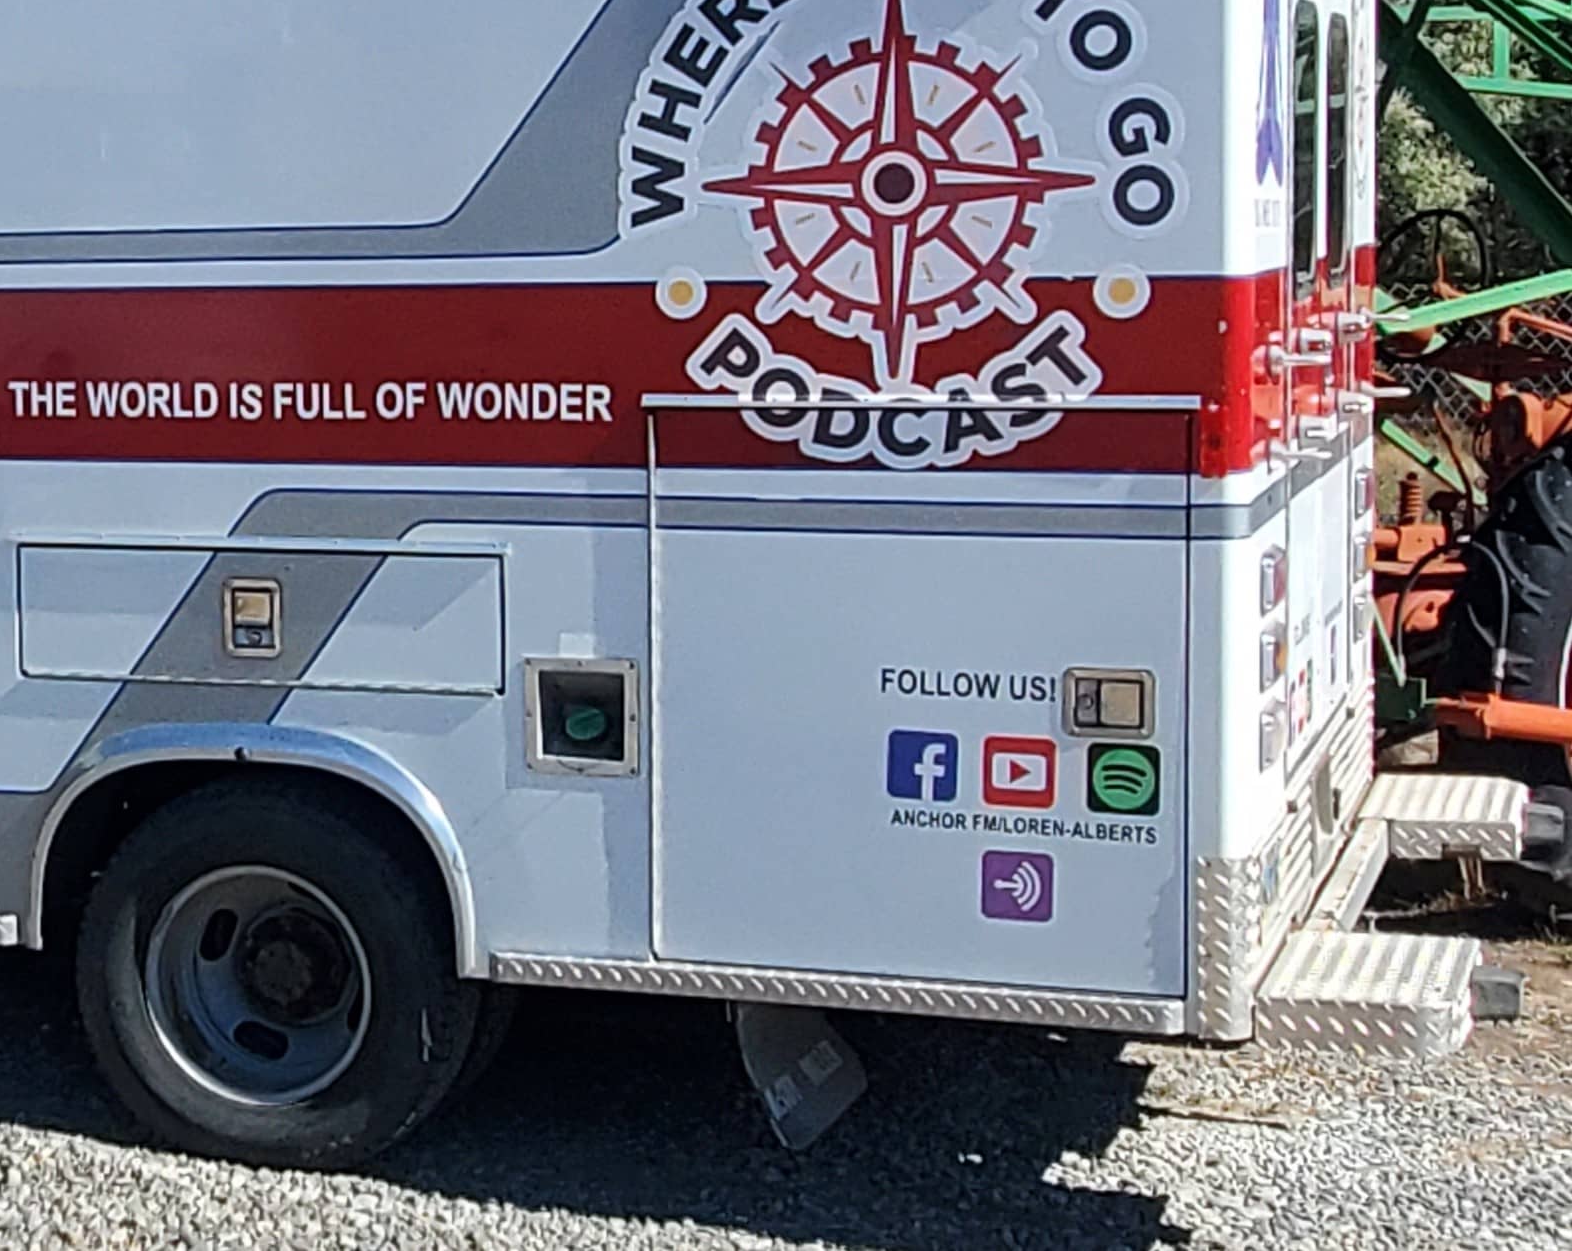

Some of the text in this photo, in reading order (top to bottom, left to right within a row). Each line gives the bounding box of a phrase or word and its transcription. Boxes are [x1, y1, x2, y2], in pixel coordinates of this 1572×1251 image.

[1107, 97, 1175, 226] GO
[8, 381, 614, 422] THE WORLD IS FULL OF WONDER
[701, 326, 1087, 457] PODCAST
[881, 668, 1056, 703] FOLLOW US!
[890, 809, 967, 830] ANCHOR
